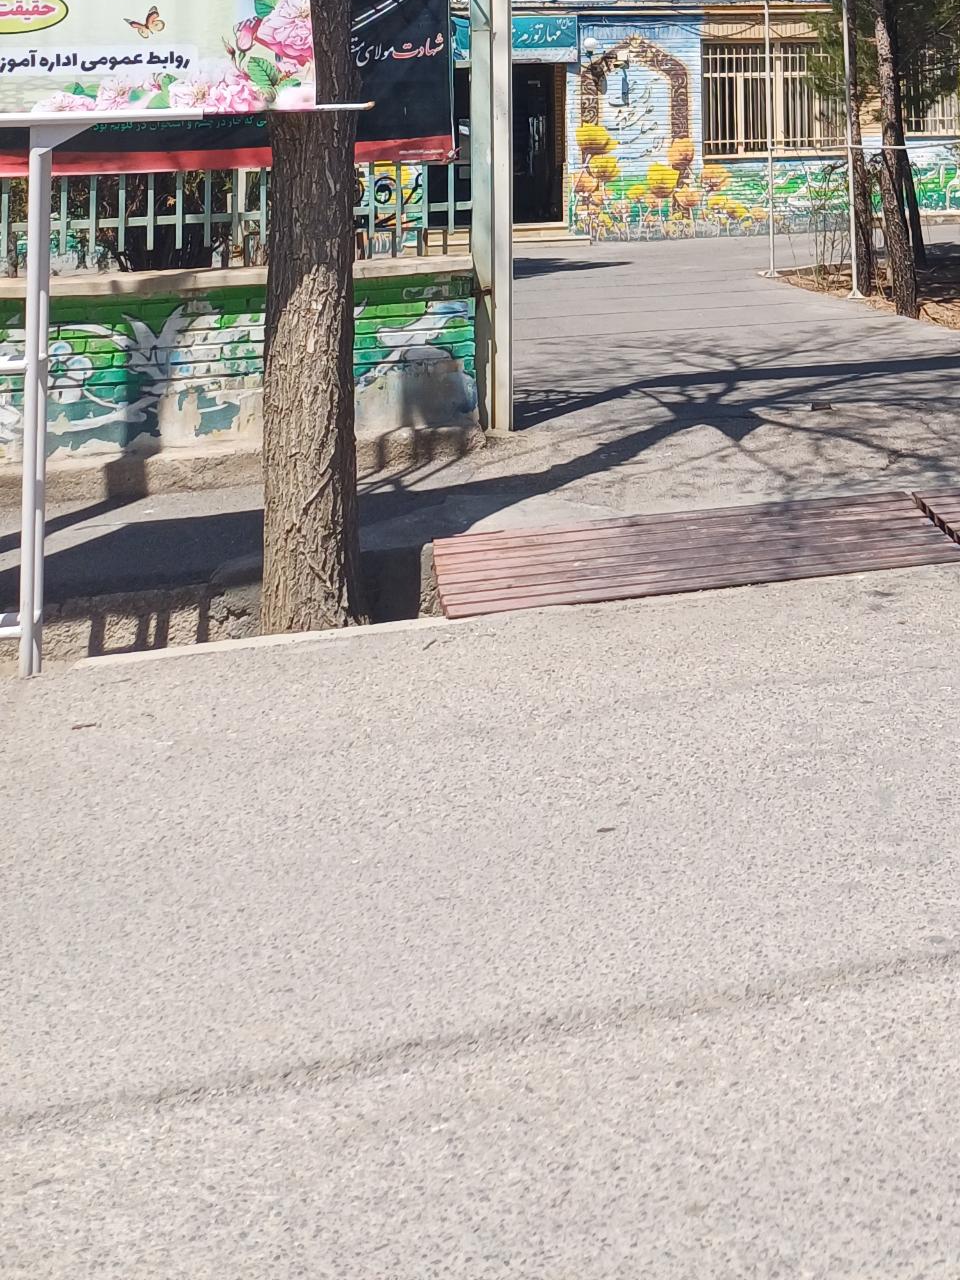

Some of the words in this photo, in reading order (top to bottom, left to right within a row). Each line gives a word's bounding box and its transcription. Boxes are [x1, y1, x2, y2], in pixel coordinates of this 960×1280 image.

[356, 41, 394, 67] مولای
[392, 32, 444, 59] شهادت
[39, 52, 78, 72] اداره
[81, 50, 143, 71] عمومی
[146, 50, 190, 69] روابط
